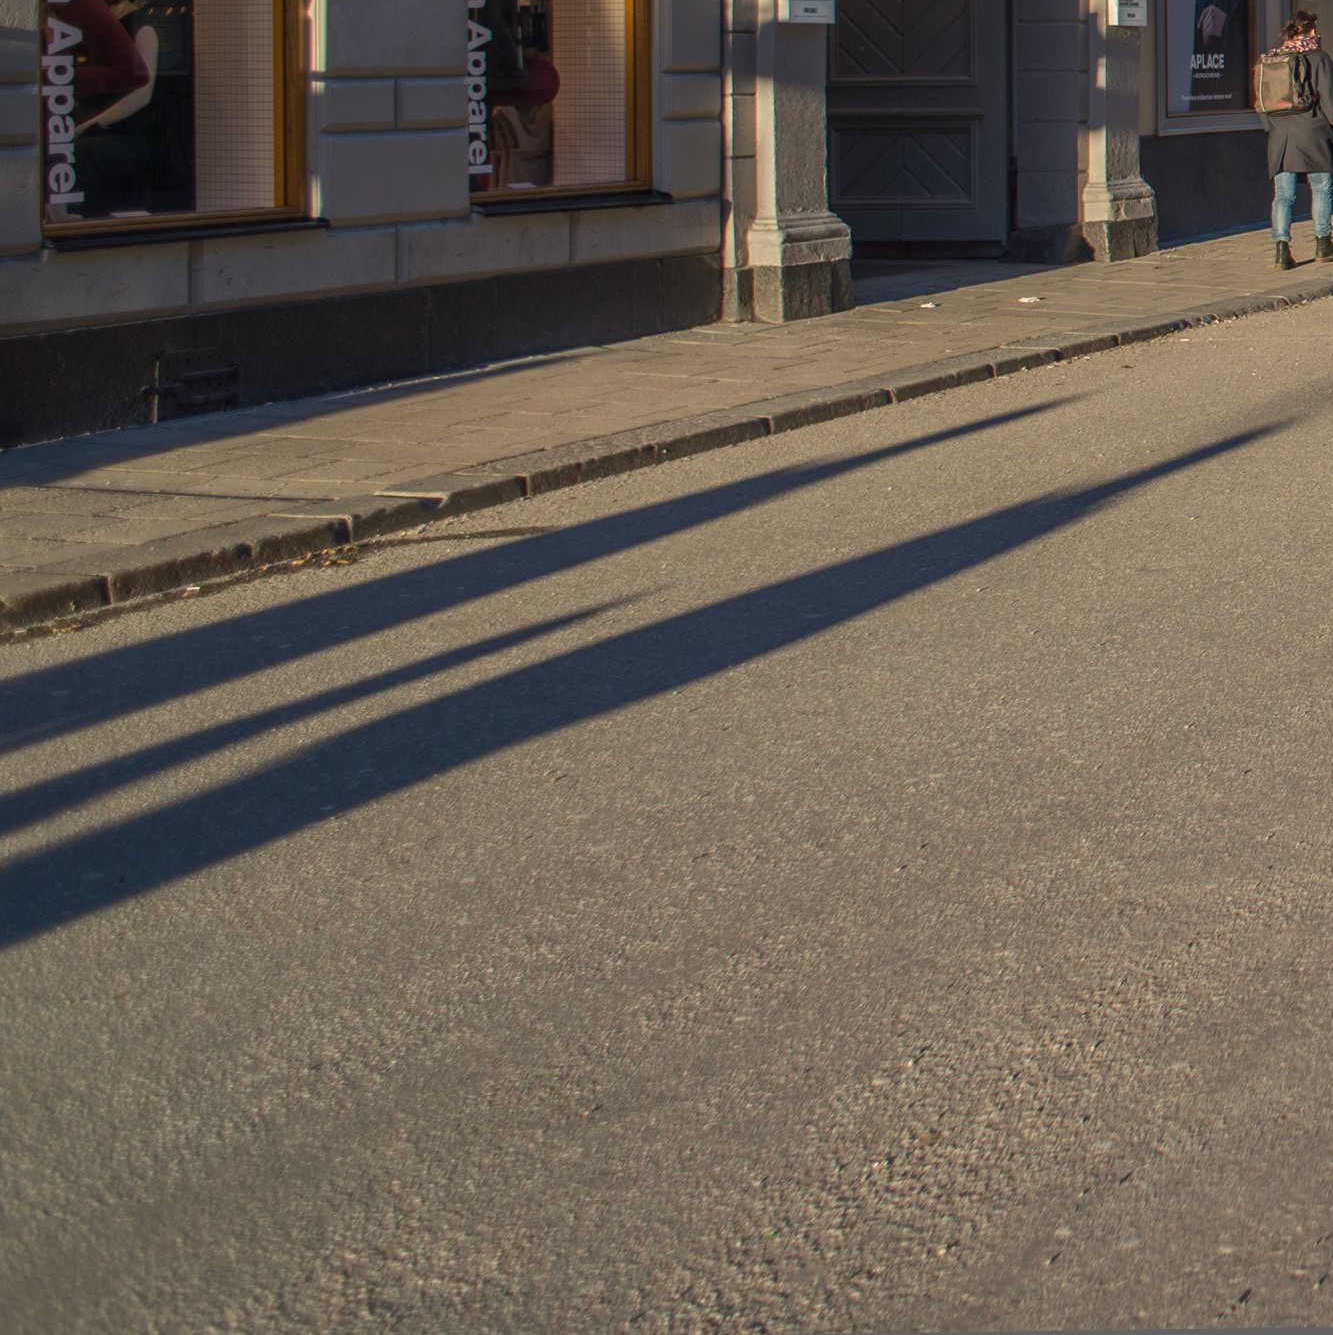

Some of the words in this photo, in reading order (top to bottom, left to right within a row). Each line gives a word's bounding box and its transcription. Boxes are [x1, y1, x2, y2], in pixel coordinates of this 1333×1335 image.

[42, 18, 85, 205] Apparel
[467, 20, 495, 175] Apparel
[1190, 53, 1225, 69] APLACE
